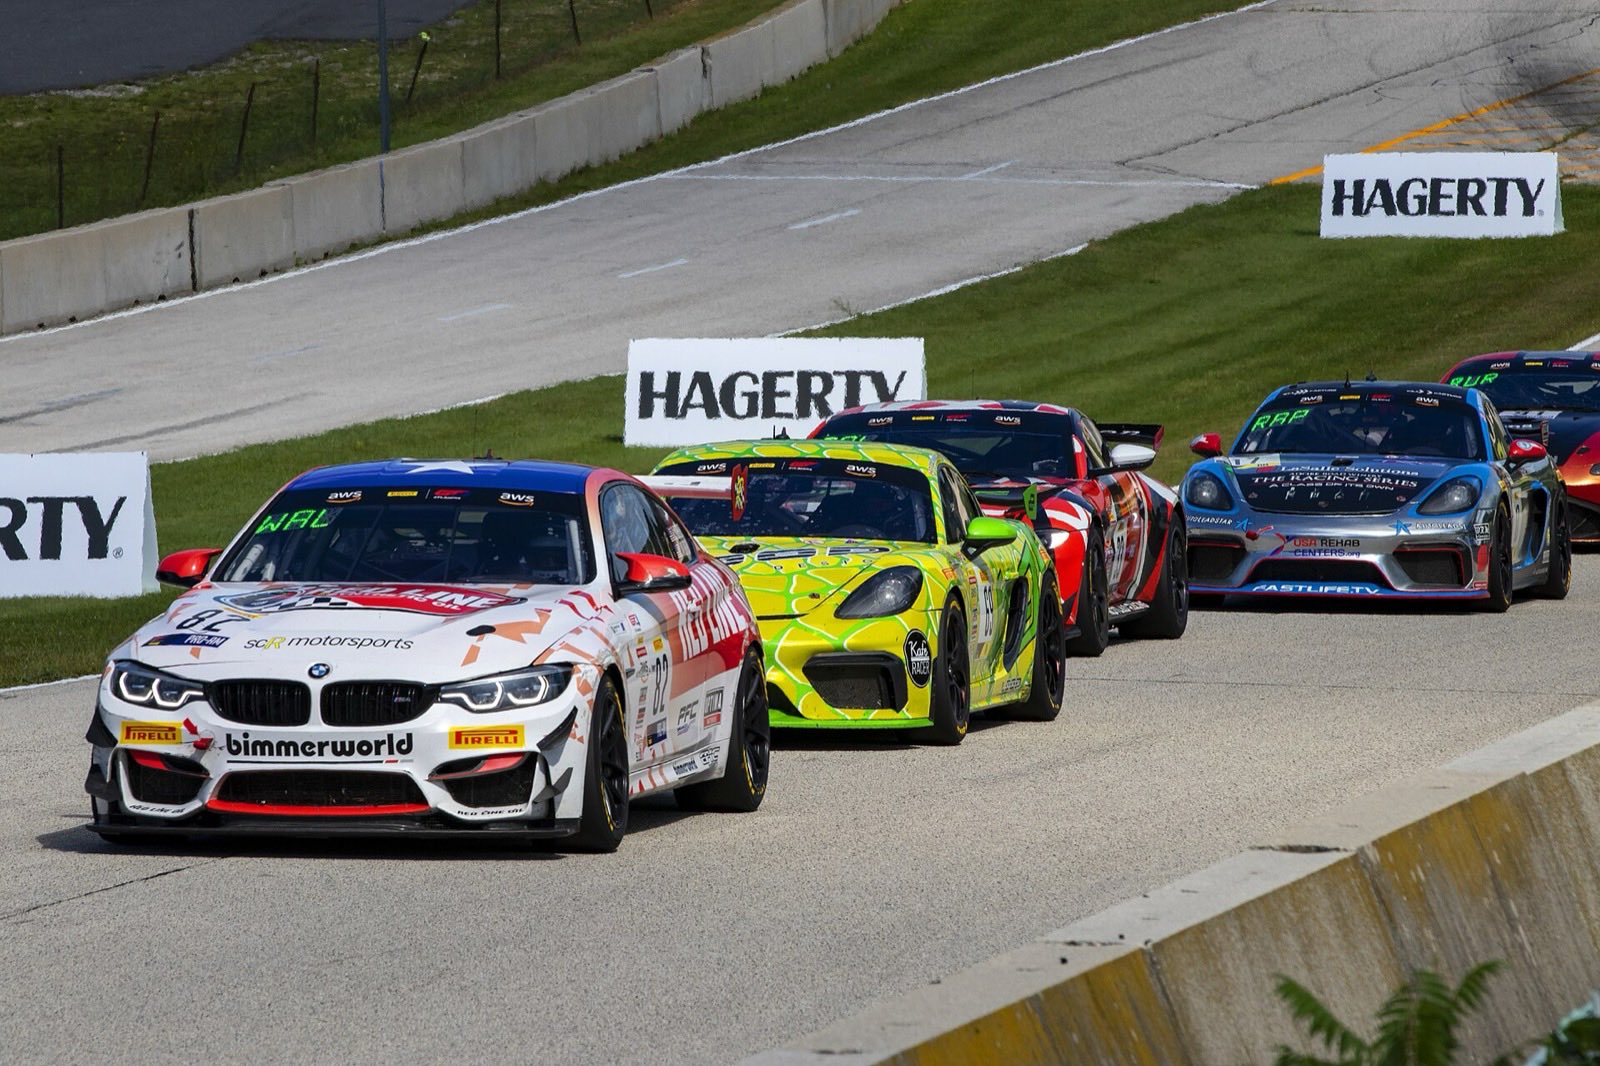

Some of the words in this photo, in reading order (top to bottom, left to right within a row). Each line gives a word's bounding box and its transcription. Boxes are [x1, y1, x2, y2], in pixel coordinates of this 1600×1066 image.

[1332, 177, 1545, 217] HAGERTY
[638, 370, 907, 419] HAGERTY
[868, 416, 893, 425] aws
[995, 415, 1020, 424] aws
[1251, 408, 1310, 432] RAP
[697, 462, 727, 472] aws
[846, 464, 877, 474] aws
[1345, 466, 1420, 476] Solutions
[1363, 477, 1418, 488] SERIES
[327, 490, 362, 500] aws
[500, 492, 534, 502] aws
[256, 508, 329, 534] WAL
[1294, 539, 1317, 547] USA
[1320, 539, 1360, 548] REHAB
[1294, 548, 1360, 557] CENTERS.org
[400, 588, 504, 609] LINE
[431, 600, 462, 610] OIL
[176, 609, 252, 632] 82
[243, 636, 286, 650] scR
[287, 635, 414, 650] motorsports
[909, 640, 929, 656] Kafe
[911, 661, 930, 675] RACER
[651, 653, 669, 716] 82
[125, 725, 176, 741] PIRELLI
[454, 729, 519, 745] PIRELLI
[226, 732, 414, 758] bimmerworld
